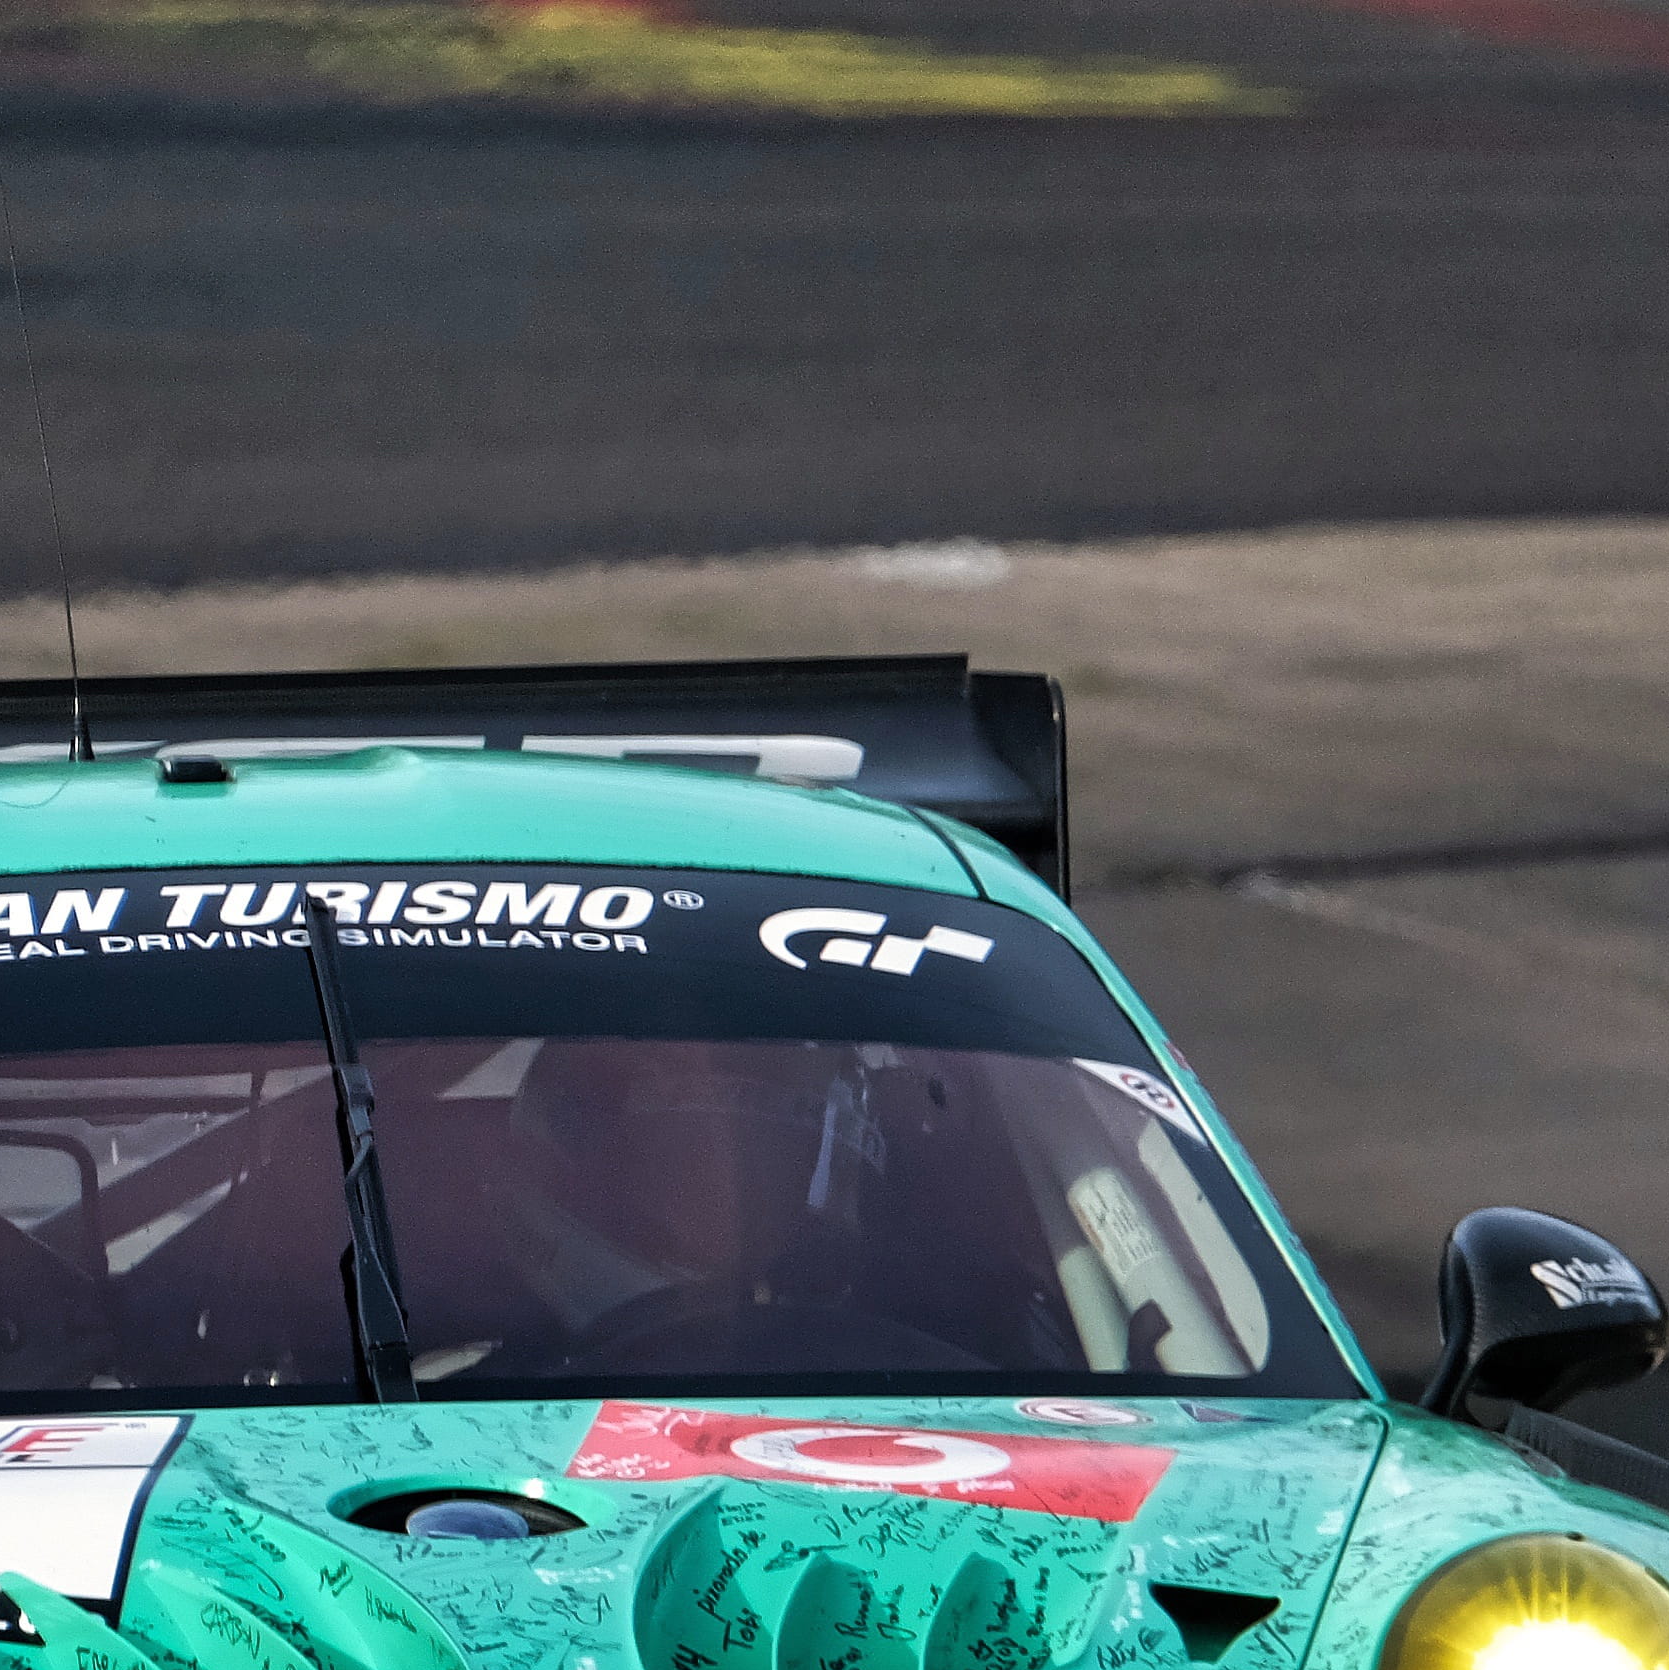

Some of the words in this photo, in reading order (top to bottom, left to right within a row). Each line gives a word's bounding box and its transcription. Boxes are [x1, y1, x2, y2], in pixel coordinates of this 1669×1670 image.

[158, 879, 657, 932] TURISMO
[99, 928, 311, 955] DRIVING
[335, 926, 649, 954] SIMULATOR
